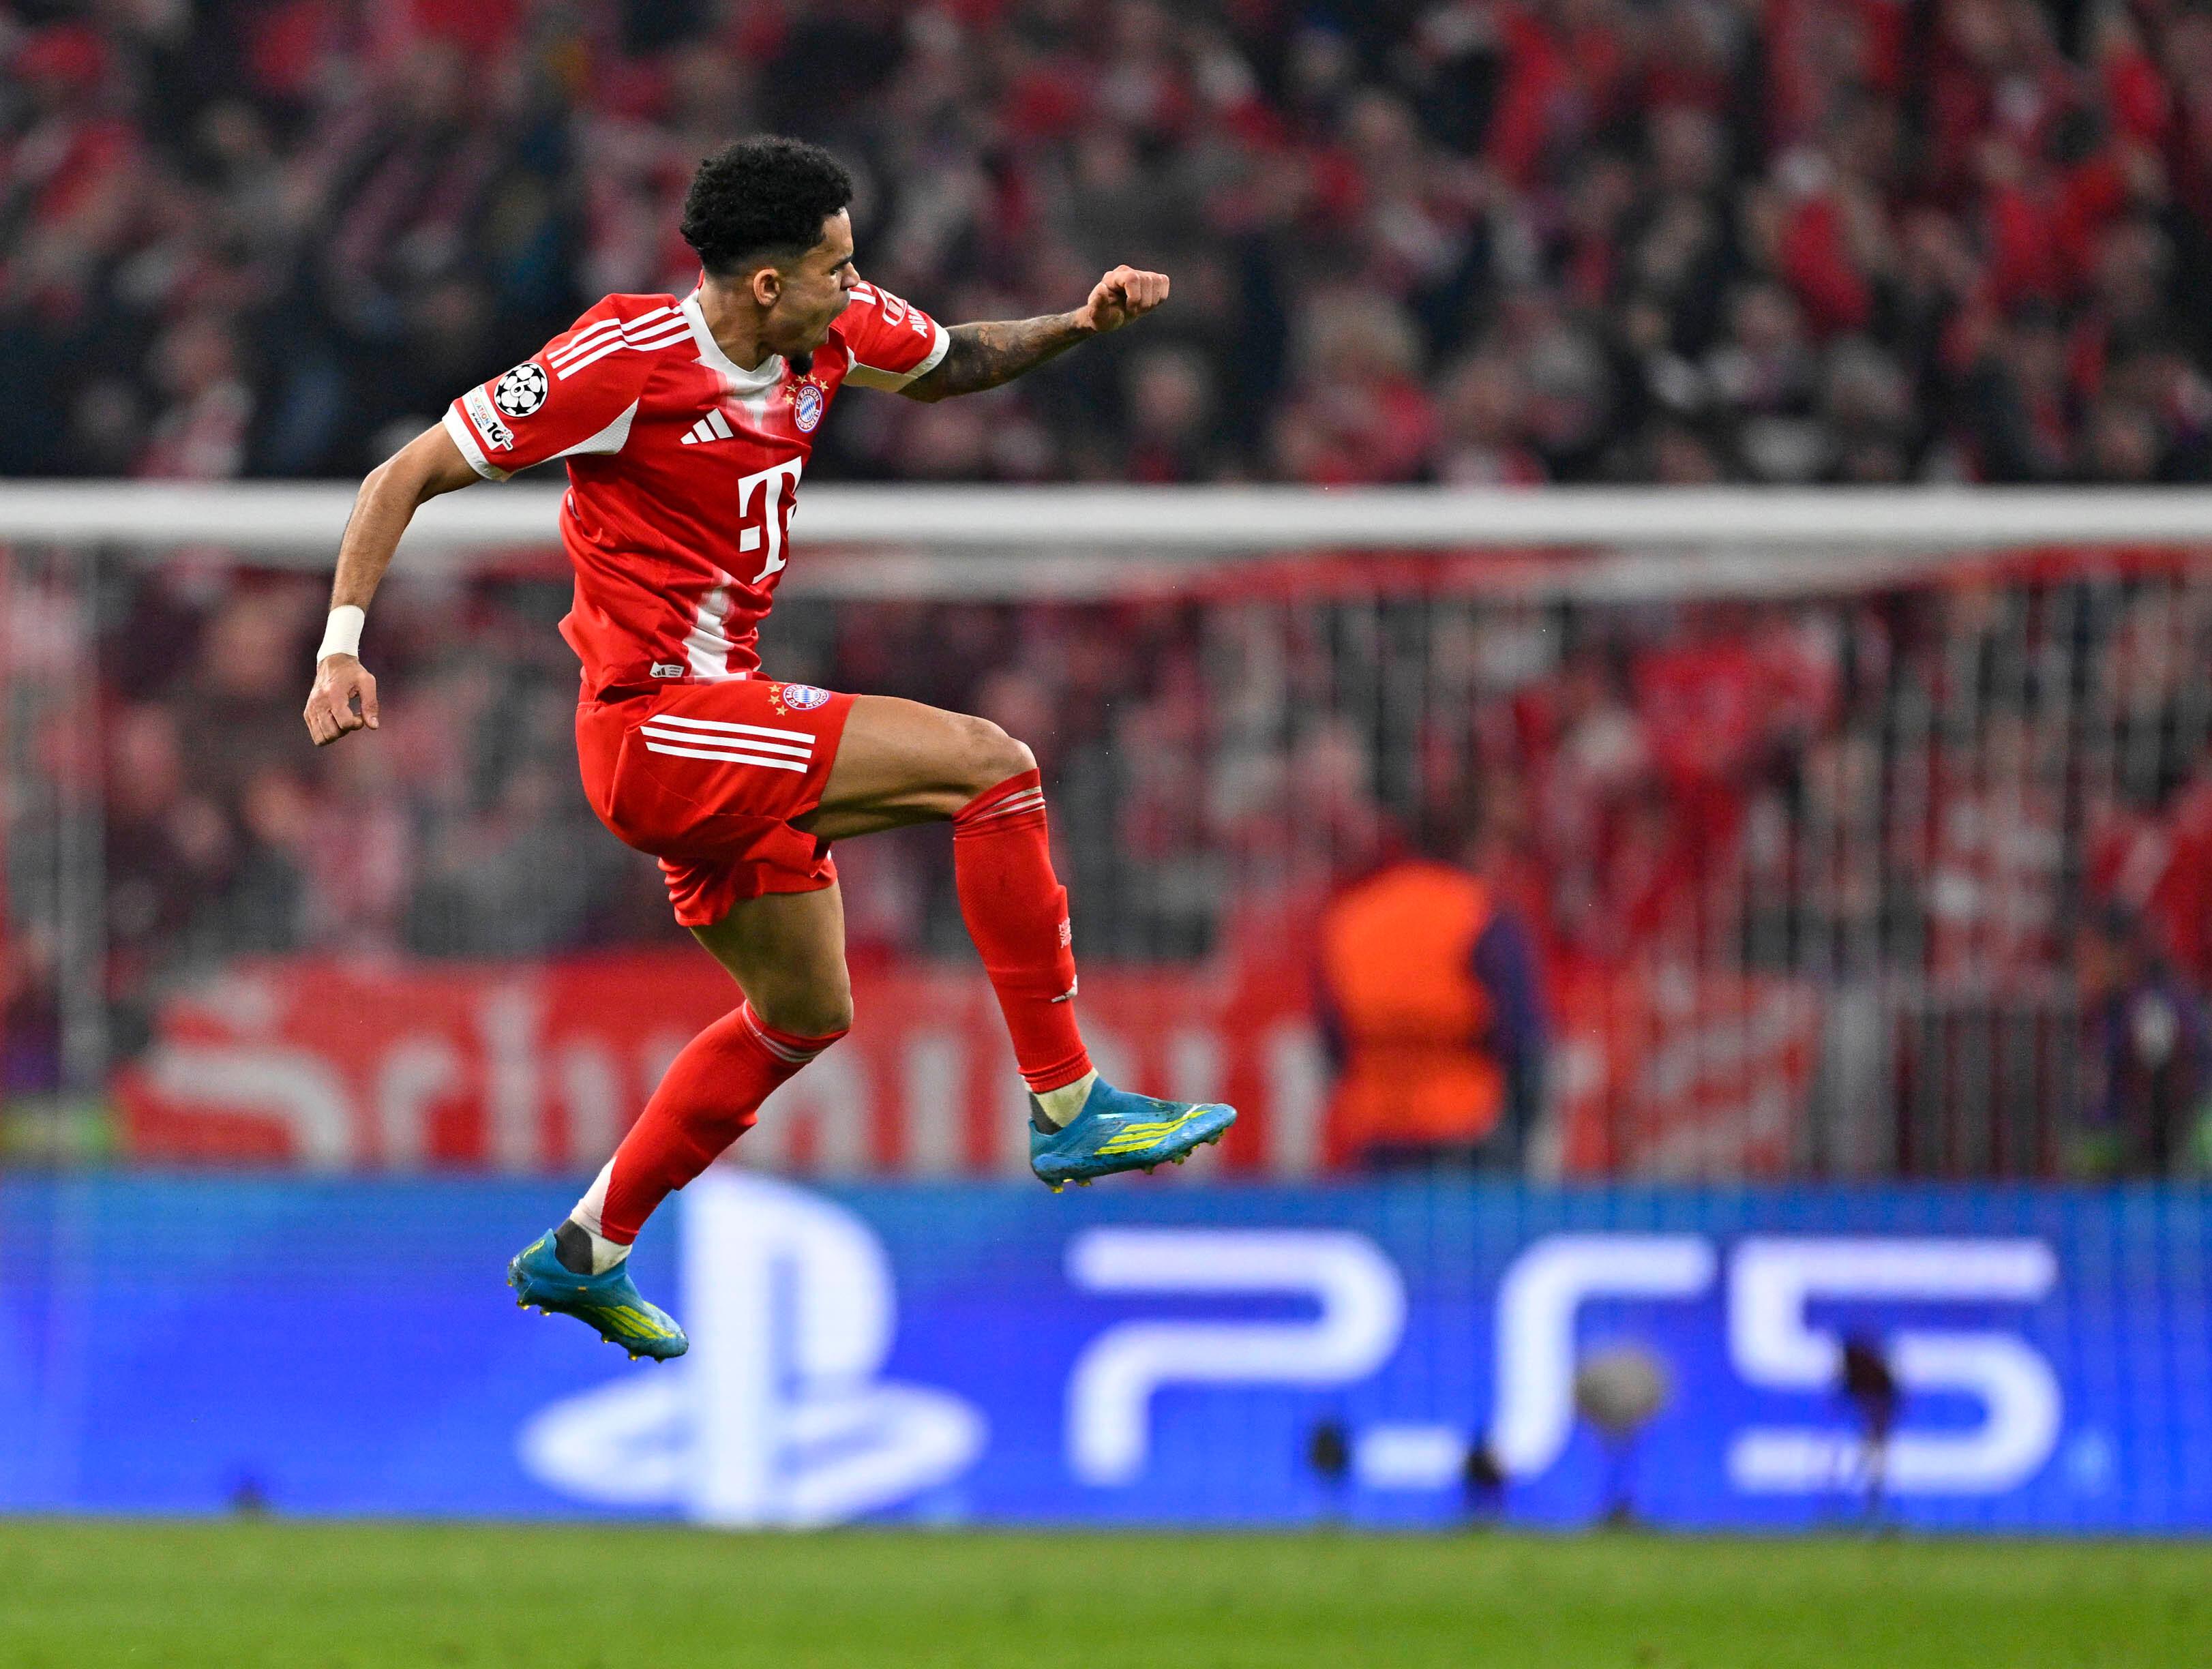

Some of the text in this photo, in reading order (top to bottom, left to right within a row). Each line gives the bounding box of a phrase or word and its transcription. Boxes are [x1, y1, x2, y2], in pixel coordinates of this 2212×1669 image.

[800, 389, 820, 402] BAYERN
[789, 699, 798, 707] FC
[1068, 1228, 2061, 1494] PS5
